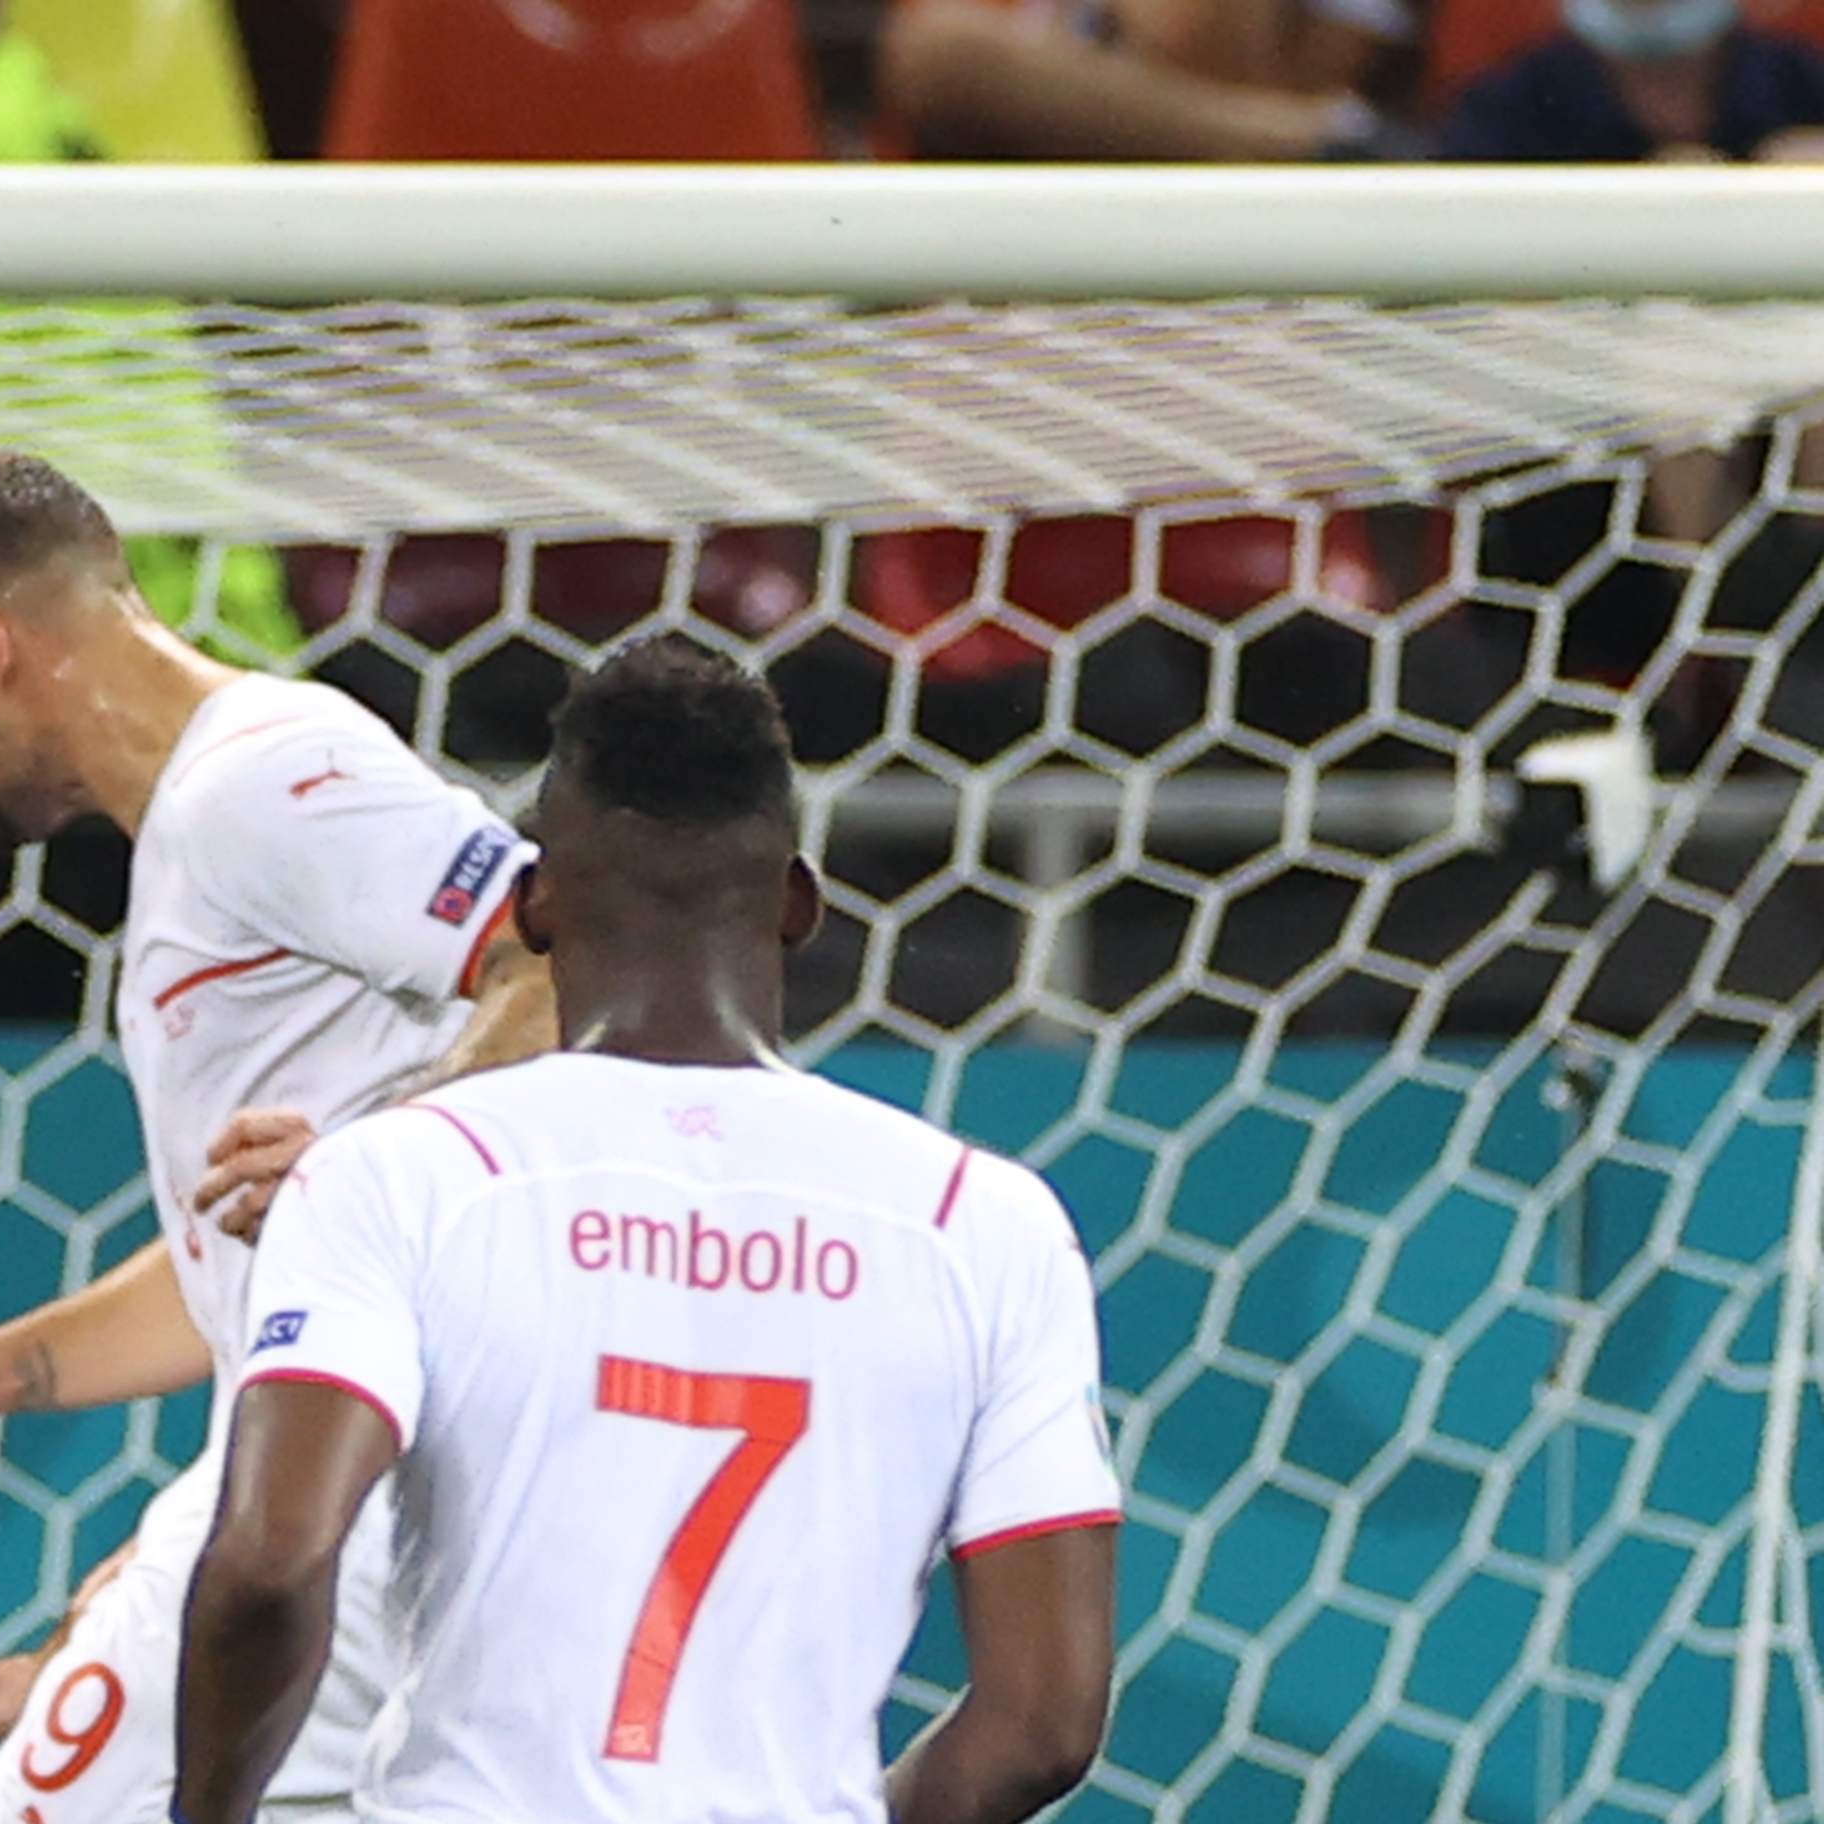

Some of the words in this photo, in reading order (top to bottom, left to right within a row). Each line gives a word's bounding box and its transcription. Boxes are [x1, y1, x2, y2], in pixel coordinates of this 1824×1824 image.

[569, 1210, 858, 1300] embolo
[595, 1353, 811, 1764] 7
[20, 1661, 126, 1791] 9
